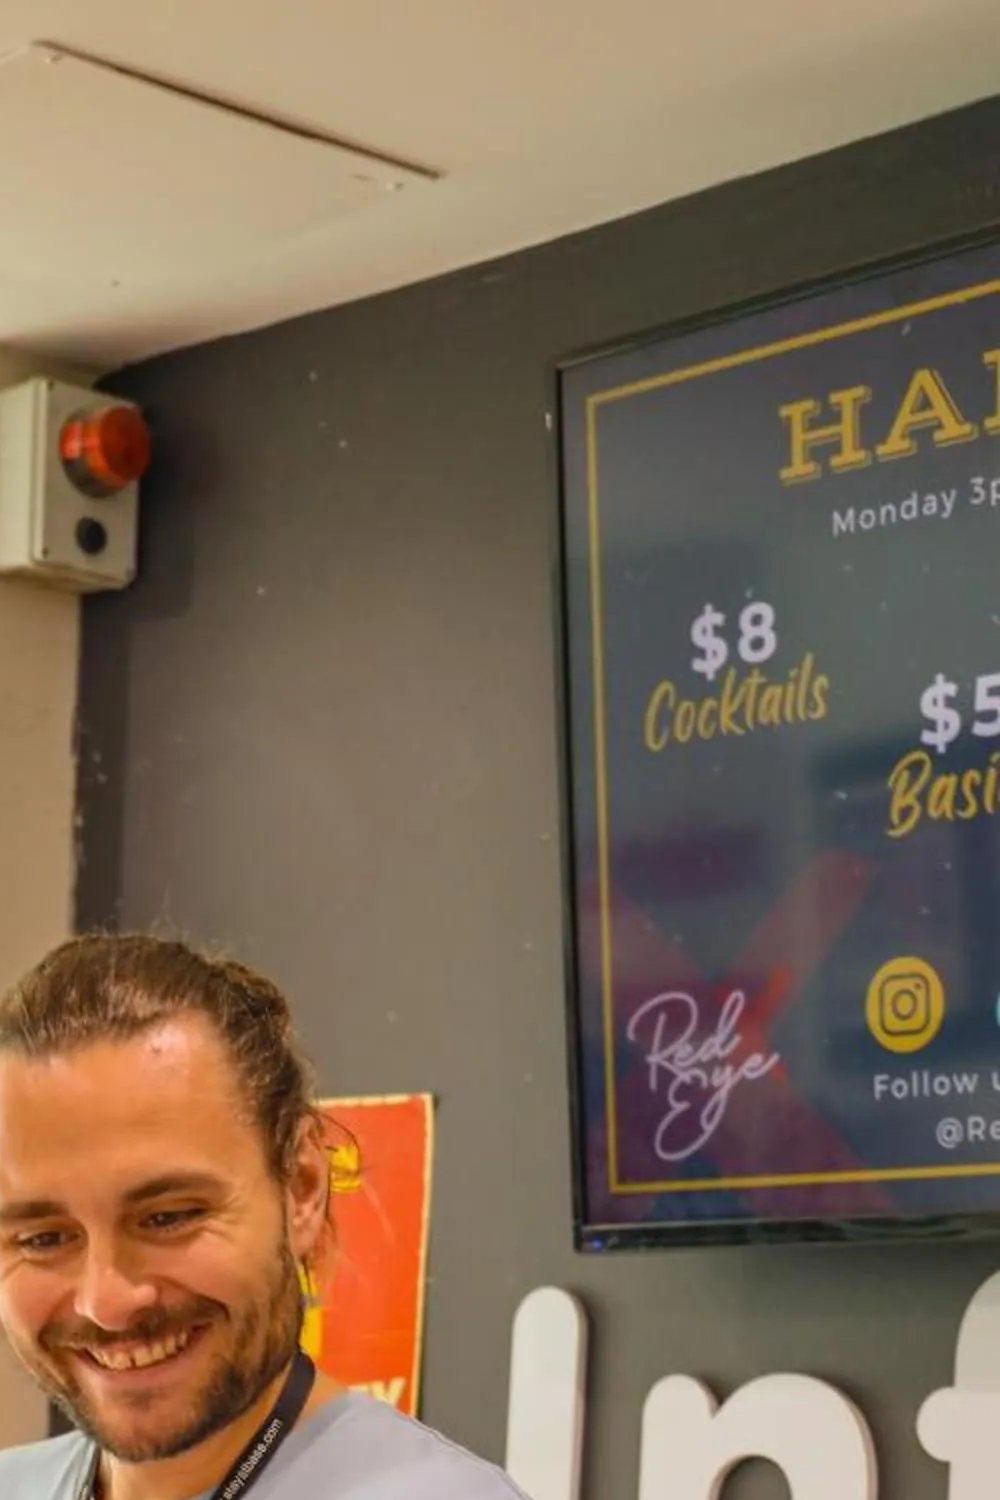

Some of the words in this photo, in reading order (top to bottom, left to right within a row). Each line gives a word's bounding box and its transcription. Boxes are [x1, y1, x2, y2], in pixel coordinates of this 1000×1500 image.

[779, 350, 1000, 485] HA
[832, 488, 957, 537] Monday
[690, 602, 777, 681] $8
[644, 652, 829, 752] Cocktails
[920, 672, 1000, 754] $5
[628, 991, 745, 1092] Red
[874, 1069, 979, 1100] Follow
[654, 1052, 780, 1160] Eye
